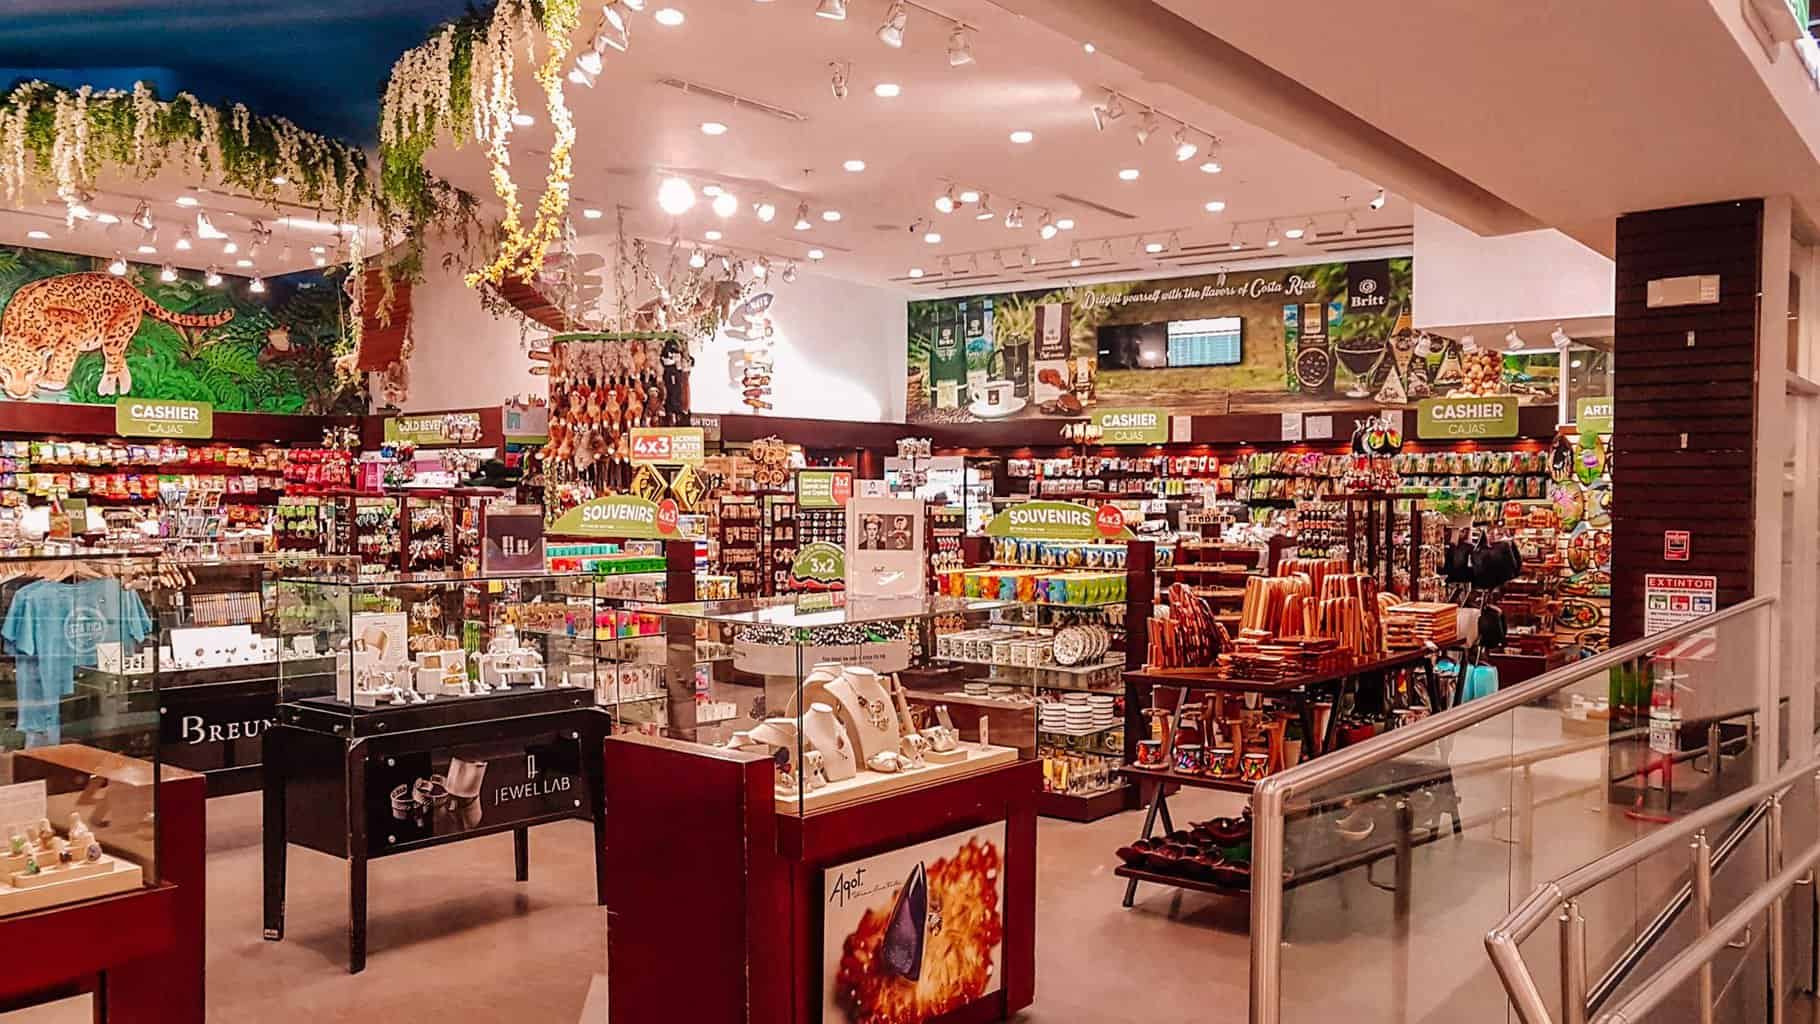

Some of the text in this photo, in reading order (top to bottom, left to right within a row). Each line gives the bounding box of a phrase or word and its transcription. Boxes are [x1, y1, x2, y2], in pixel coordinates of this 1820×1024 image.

[1081, 275, 1317, 309] Delight yourself with the flavors of Costa Rica
[1351, 295, 1385, 308] Britt
[130, 404, 200, 421] CASHIER
[1432, 404, 1504, 419] CASHIER
[1102, 414, 1157, 427] CASHIER
[147, 422, 184, 434] CAJAS
[1448, 424, 1486, 434] CAJAS
[1115, 431, 1143, 441] CAJAS
[634, 437, 670, 455] 4x3
[583, 504, 654, 523] SOUVENIRS
[659, 510, 676, 522] 4x3
[1009, 510, 1091, 526] SOUVENIRS
[1098, 513, 1122, 525] 4x3
[811, 558, 836, 573] 3x2
[1649, 579, 1713, 587] EXTINTOR
[495, 776, 570, 806] JEWEL LAB
